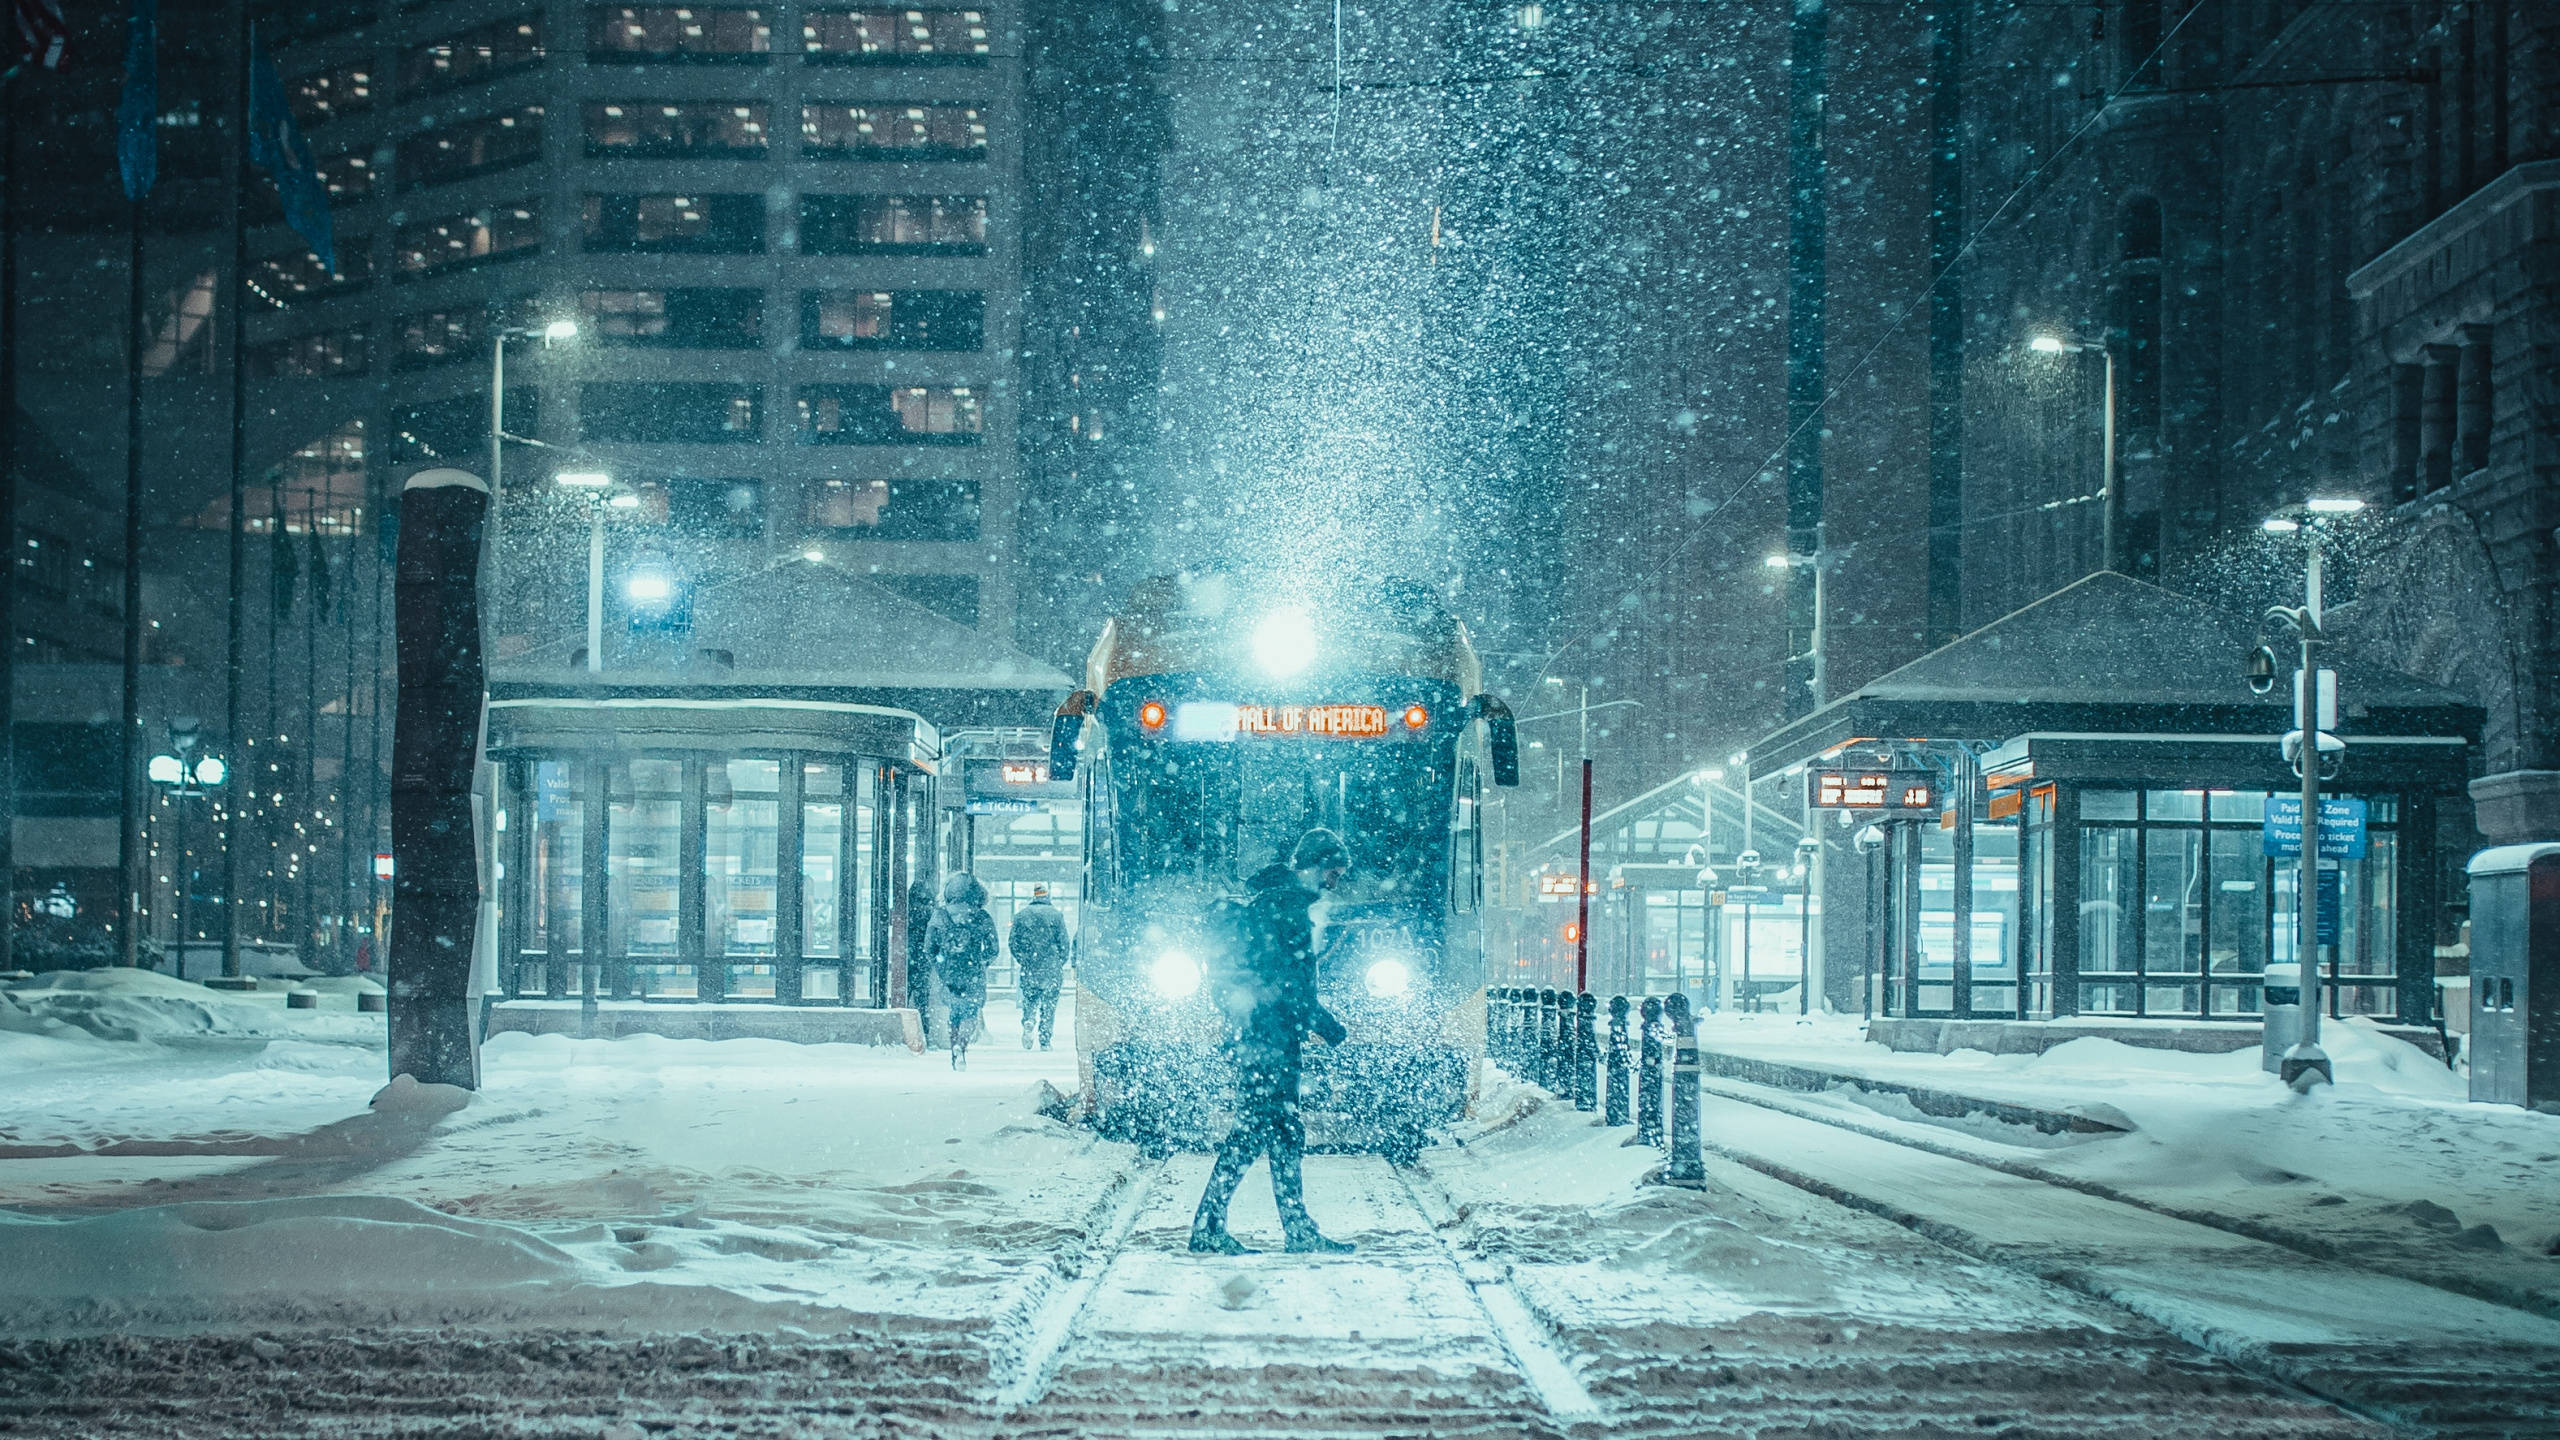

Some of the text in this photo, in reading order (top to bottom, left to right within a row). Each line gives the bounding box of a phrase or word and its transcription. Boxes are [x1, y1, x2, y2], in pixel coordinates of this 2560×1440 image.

[1237, 707, 1383, 732] MALL OF AMERICA
[988, 801, 1031, 812] TICKETS
[2281, 803, 2301, 813] Paid
[2325, 804, 2350, 815] Zone
[2271, 814, 2293, 825] Valid
[2318, 816, 2359, 828] Required
[2275, 829, 2302, 840] Proce
[2328, 832, 2356, 842] ticket
[2321, 844, 2349, 854] ahead
